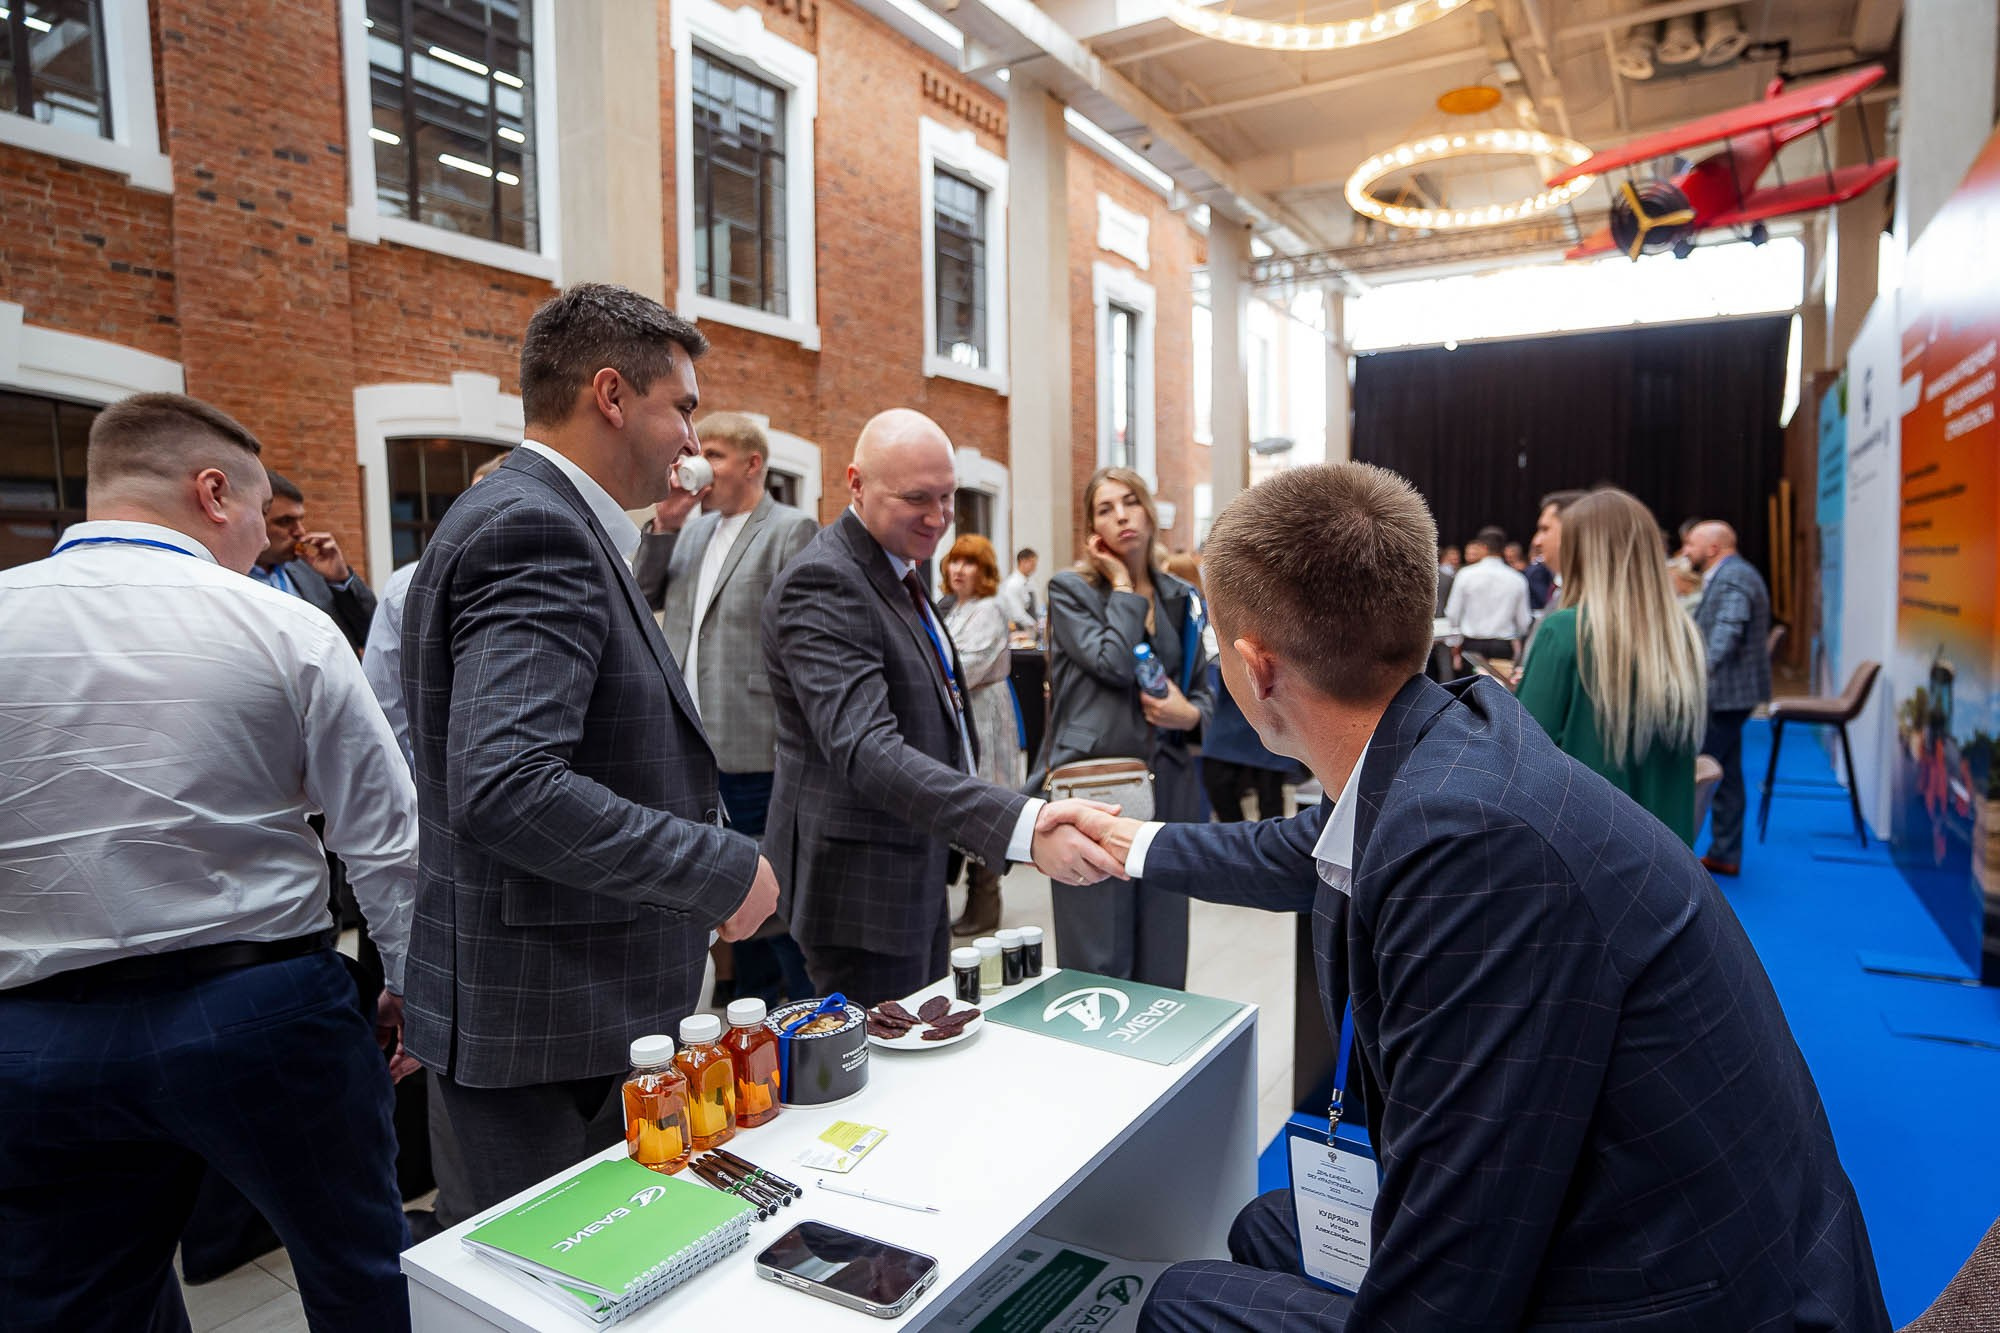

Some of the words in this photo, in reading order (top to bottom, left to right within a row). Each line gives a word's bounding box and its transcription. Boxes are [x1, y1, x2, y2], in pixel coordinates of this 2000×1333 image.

[1106, 998, 1179, 1042] БАЗИС
[551, 1207, 632, 1253] БАЗИС
[1318, 1208, 1360, 1228] КУДРЯШОВ
